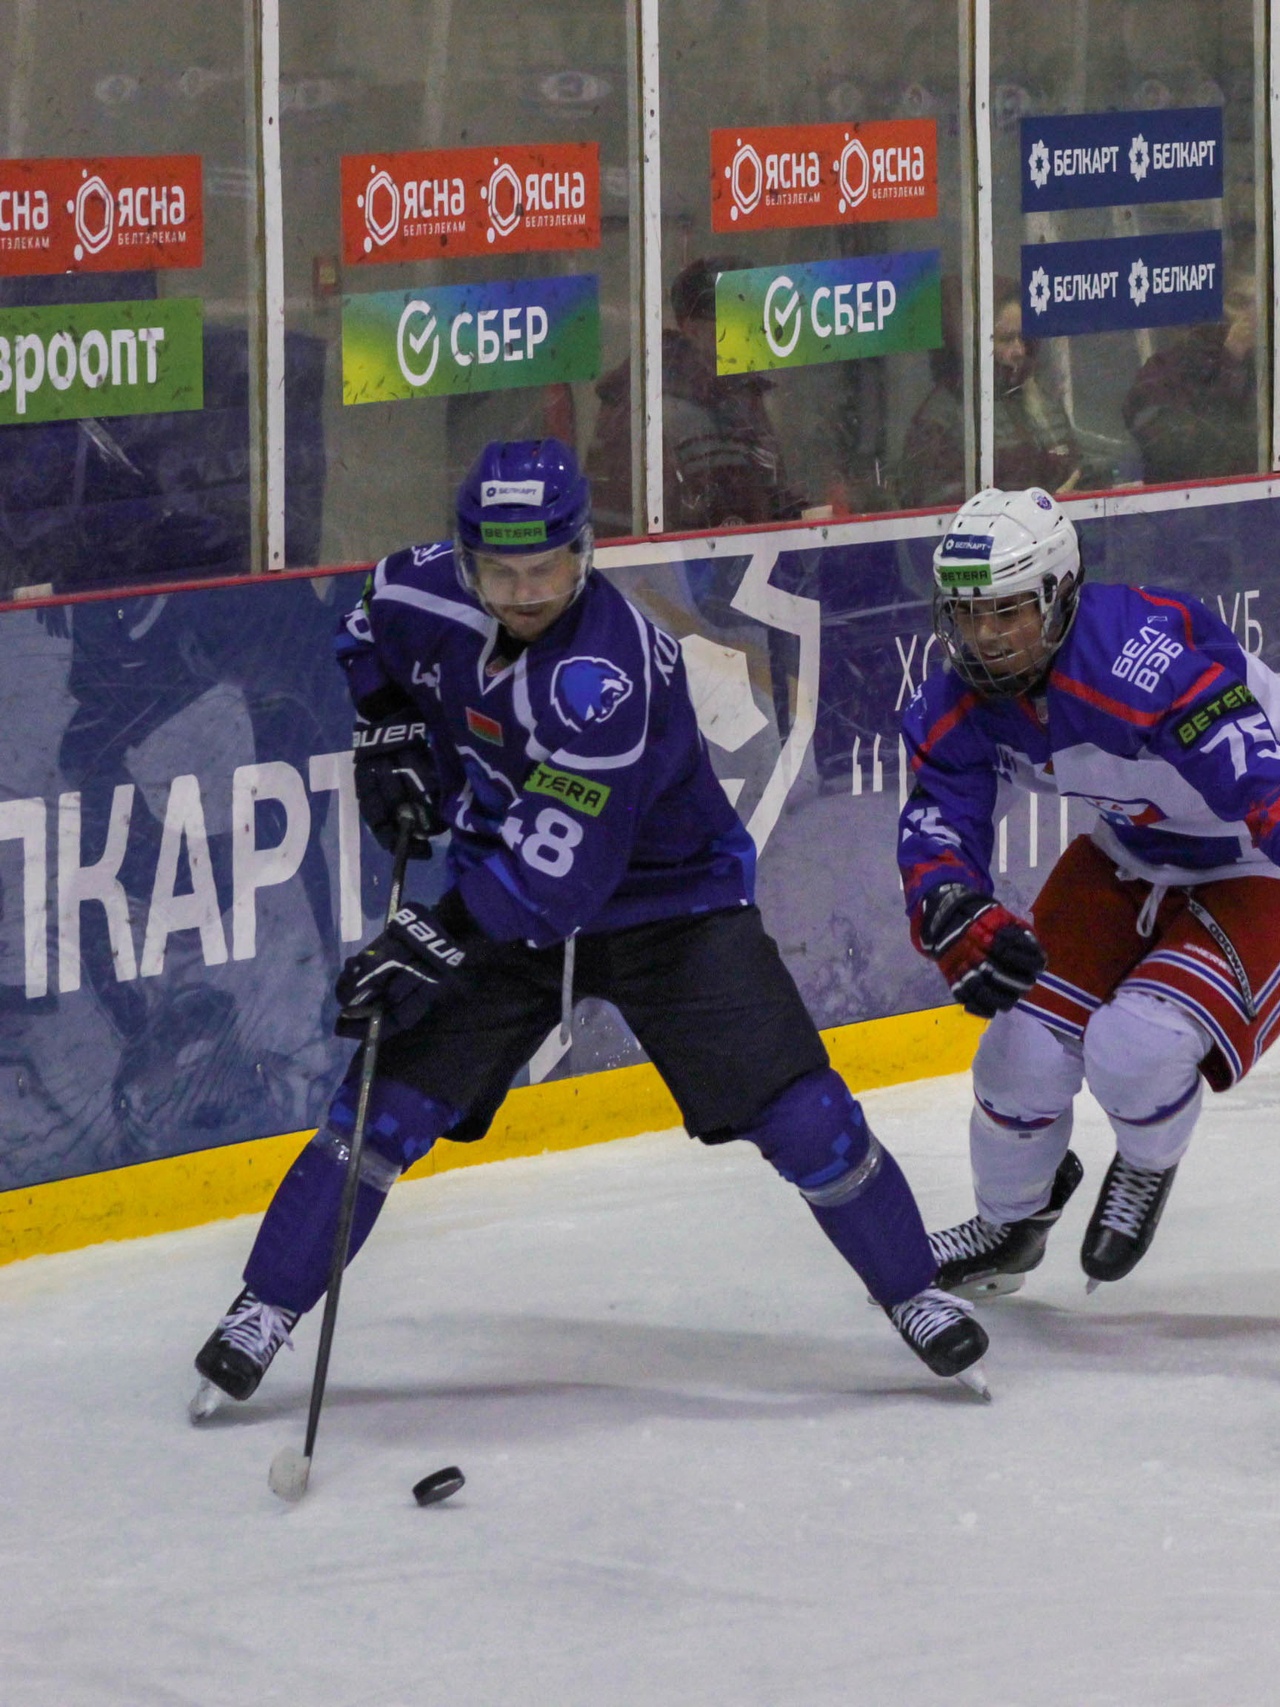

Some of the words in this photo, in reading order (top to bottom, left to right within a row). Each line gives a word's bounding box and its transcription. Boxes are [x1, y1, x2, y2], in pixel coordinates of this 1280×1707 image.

[1054, 146, 1119, 176] БЕЛКАРТ
[1153, 140, 1216, 170] БЕЛКАРТ
[1054, 272, 1119, 303] БЕЛКАРТ
[1152, 263, 1215, 294] БЕЛКАРТ
[811, 280, 896, 338] СБЕР
[451, 306, 548, 366] СБЕР
[527, 768, 602, 808] TERA
